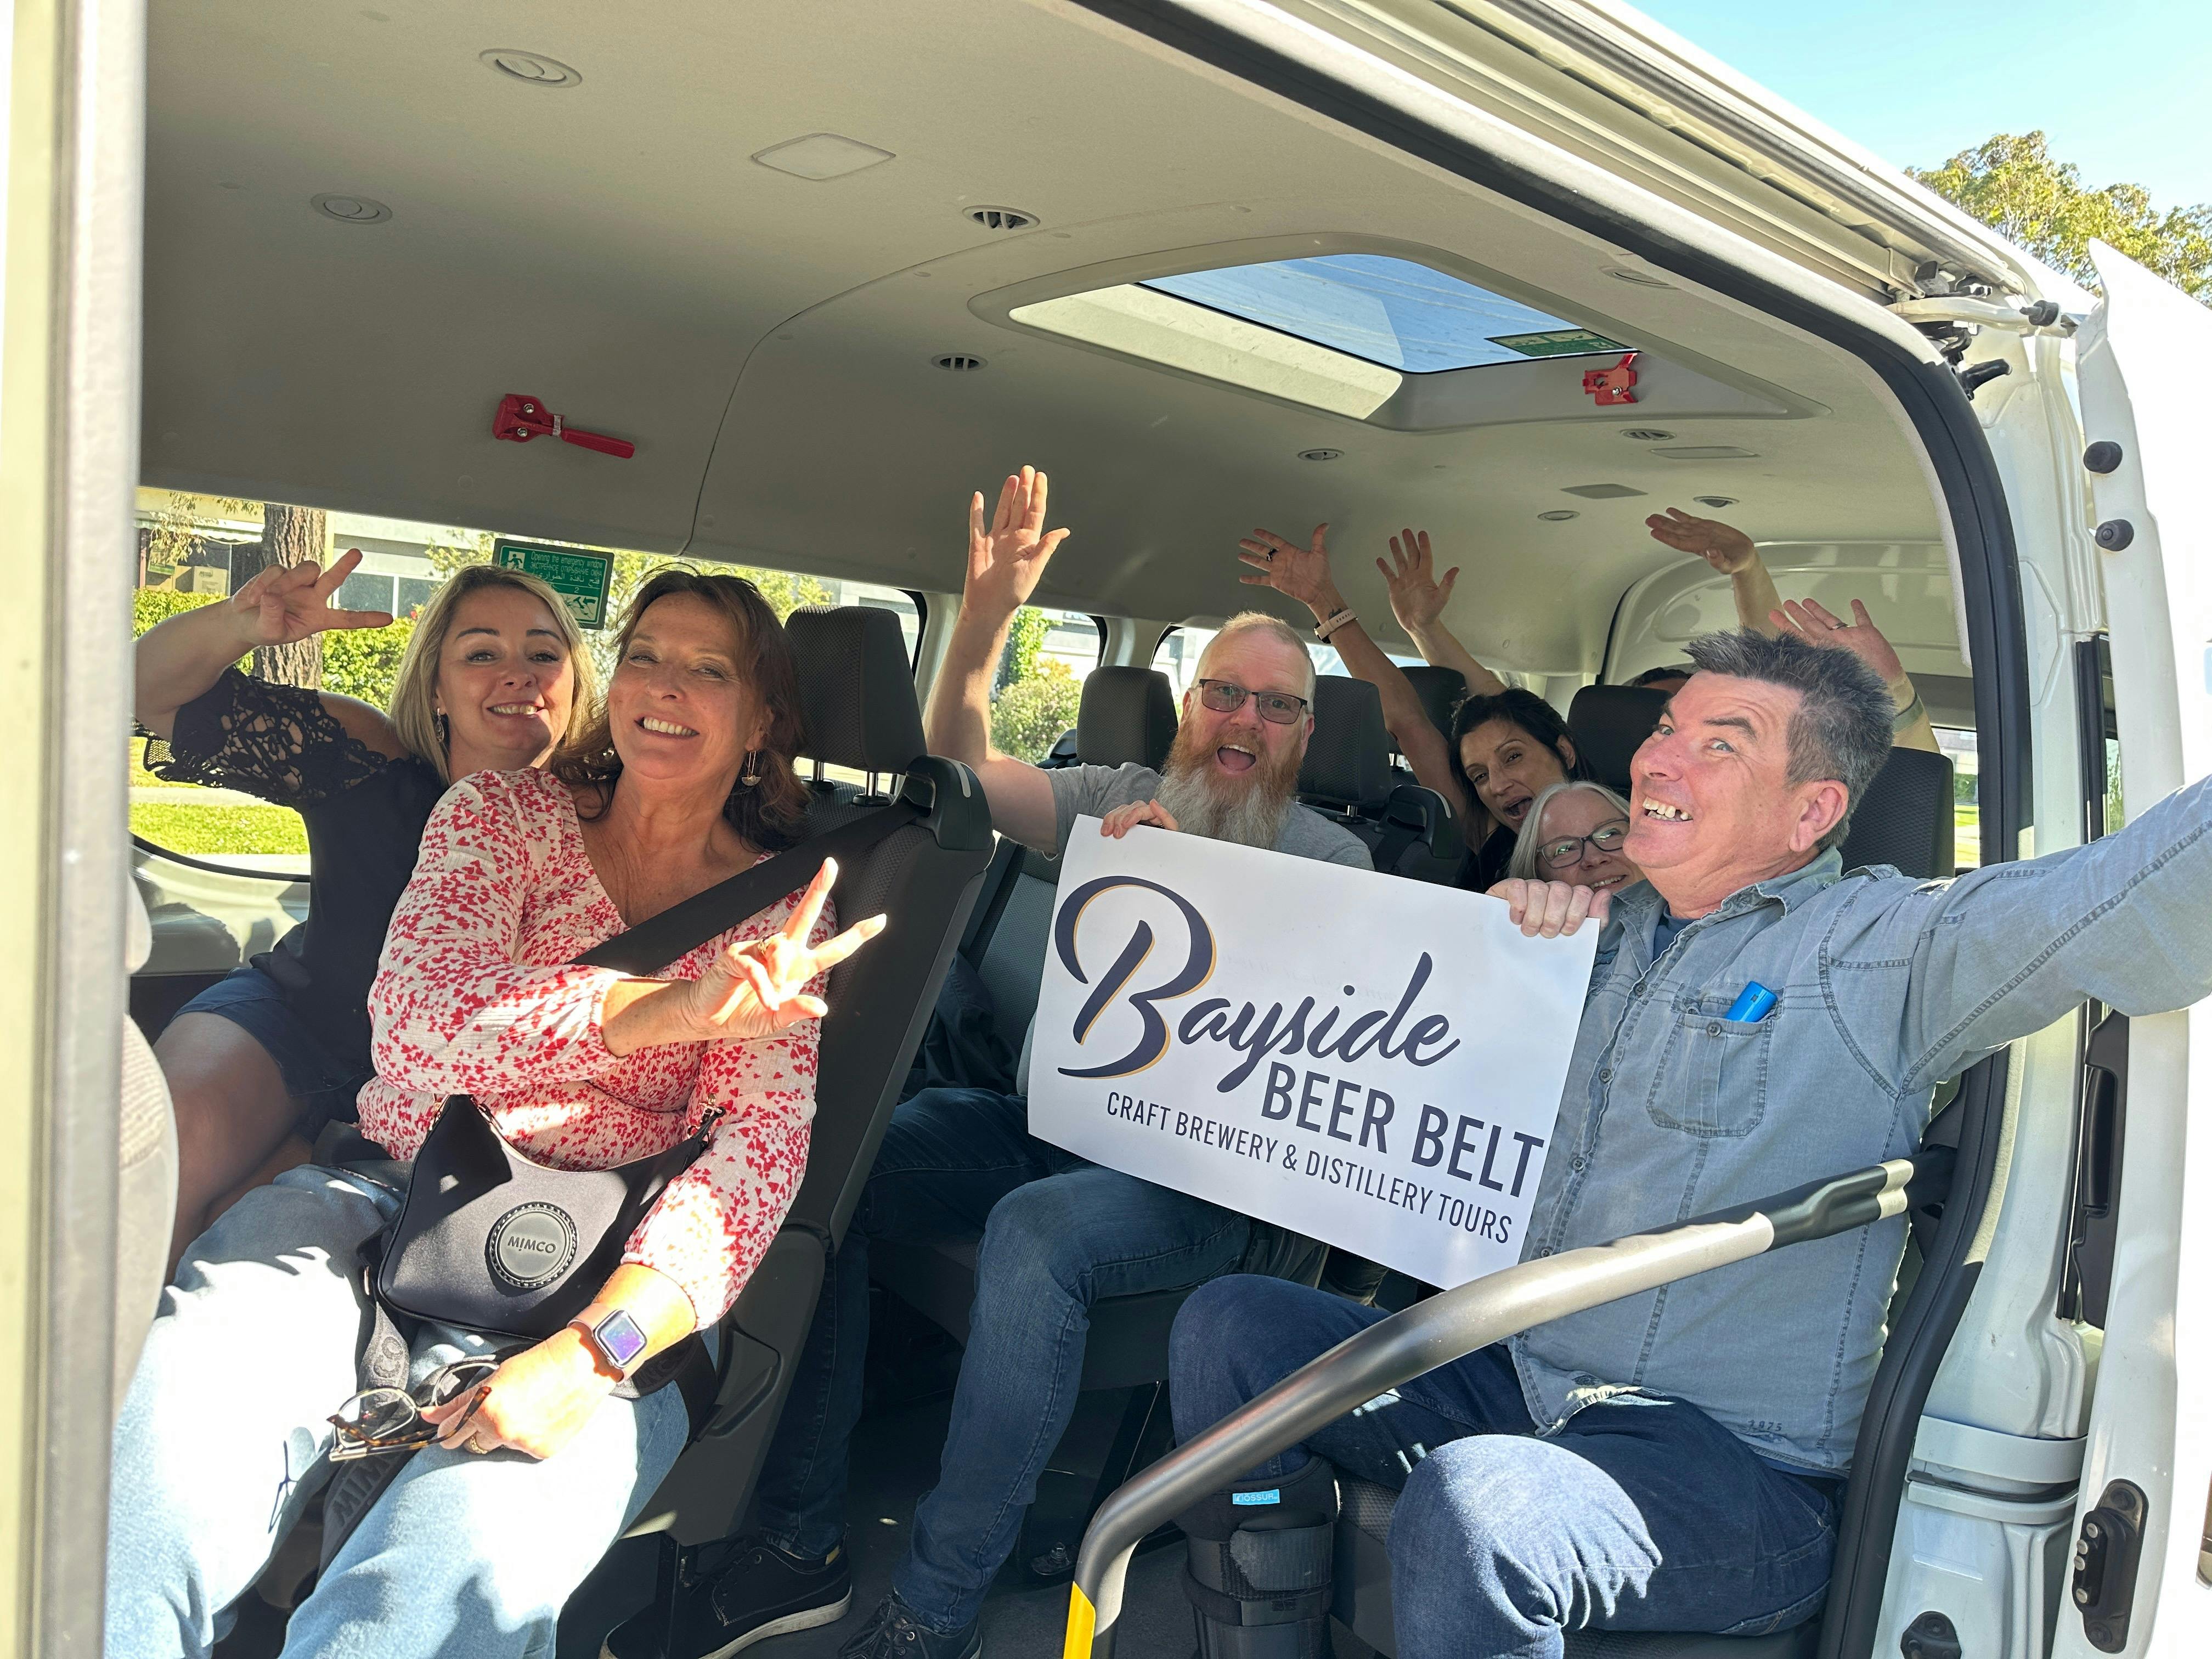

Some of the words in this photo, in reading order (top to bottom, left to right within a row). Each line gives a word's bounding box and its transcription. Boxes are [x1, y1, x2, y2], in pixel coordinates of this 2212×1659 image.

[531, 551, 550, 563] Opening
[561, 557, 584, 567] emergency
[587, 560, 603, 568] window
[1054, 876, 1461, 1093] Bayside
[1107, 1092, 1171, 1131] CRAFT
[1175, 1111, 1279, 1163] BREWERY
[1282, 1144, 1297, 1171] &
[1305, 1150, 1434, 1214] DISTILLERY
[1438, 1193, 1512, 1244] TOURS
[1261, 1061, 1395, 1154] BEER
[1411, 1103, 1545, 1198] BELT
